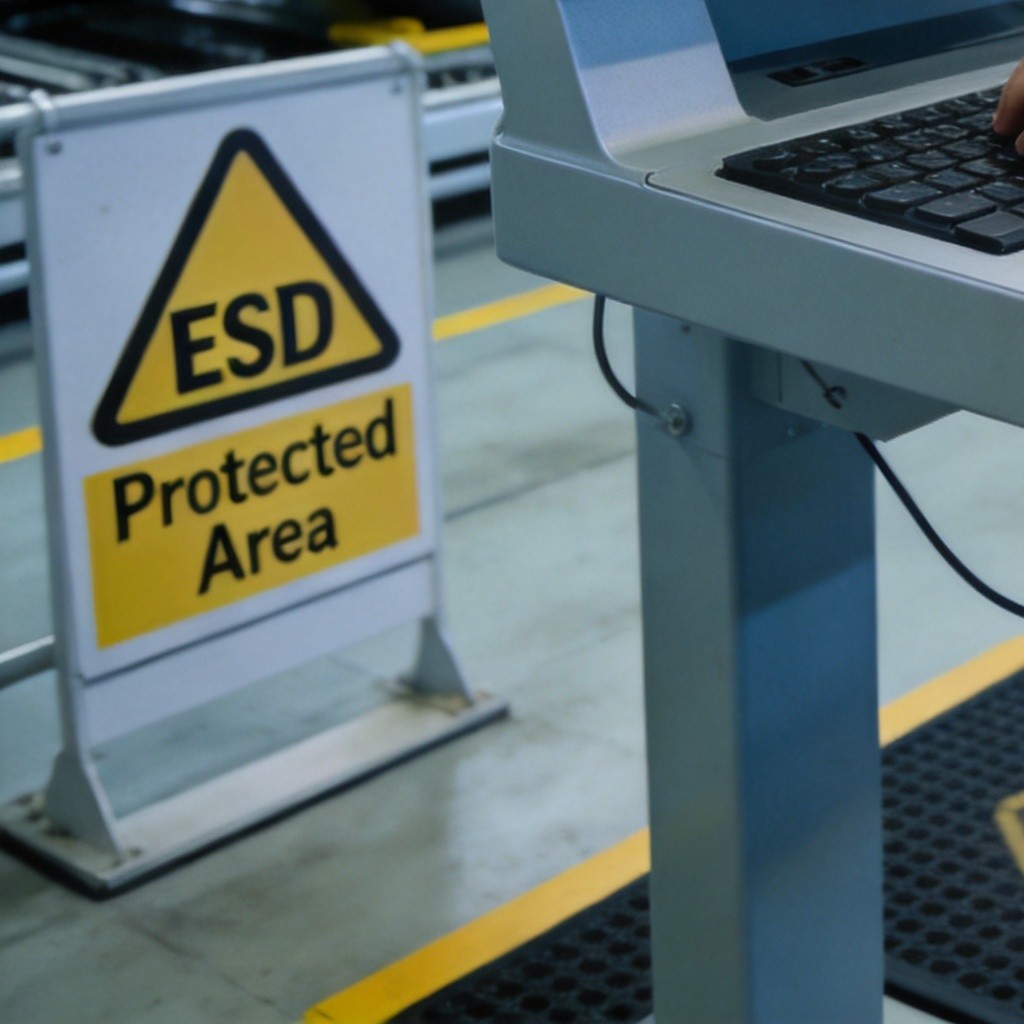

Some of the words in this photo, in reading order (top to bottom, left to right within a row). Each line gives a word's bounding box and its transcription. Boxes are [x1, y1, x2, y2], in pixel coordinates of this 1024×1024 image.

[169, 280, 334, 395] ESD
[112, 398, 396, 543] Protected
[197, 506, 338, 596] Area
